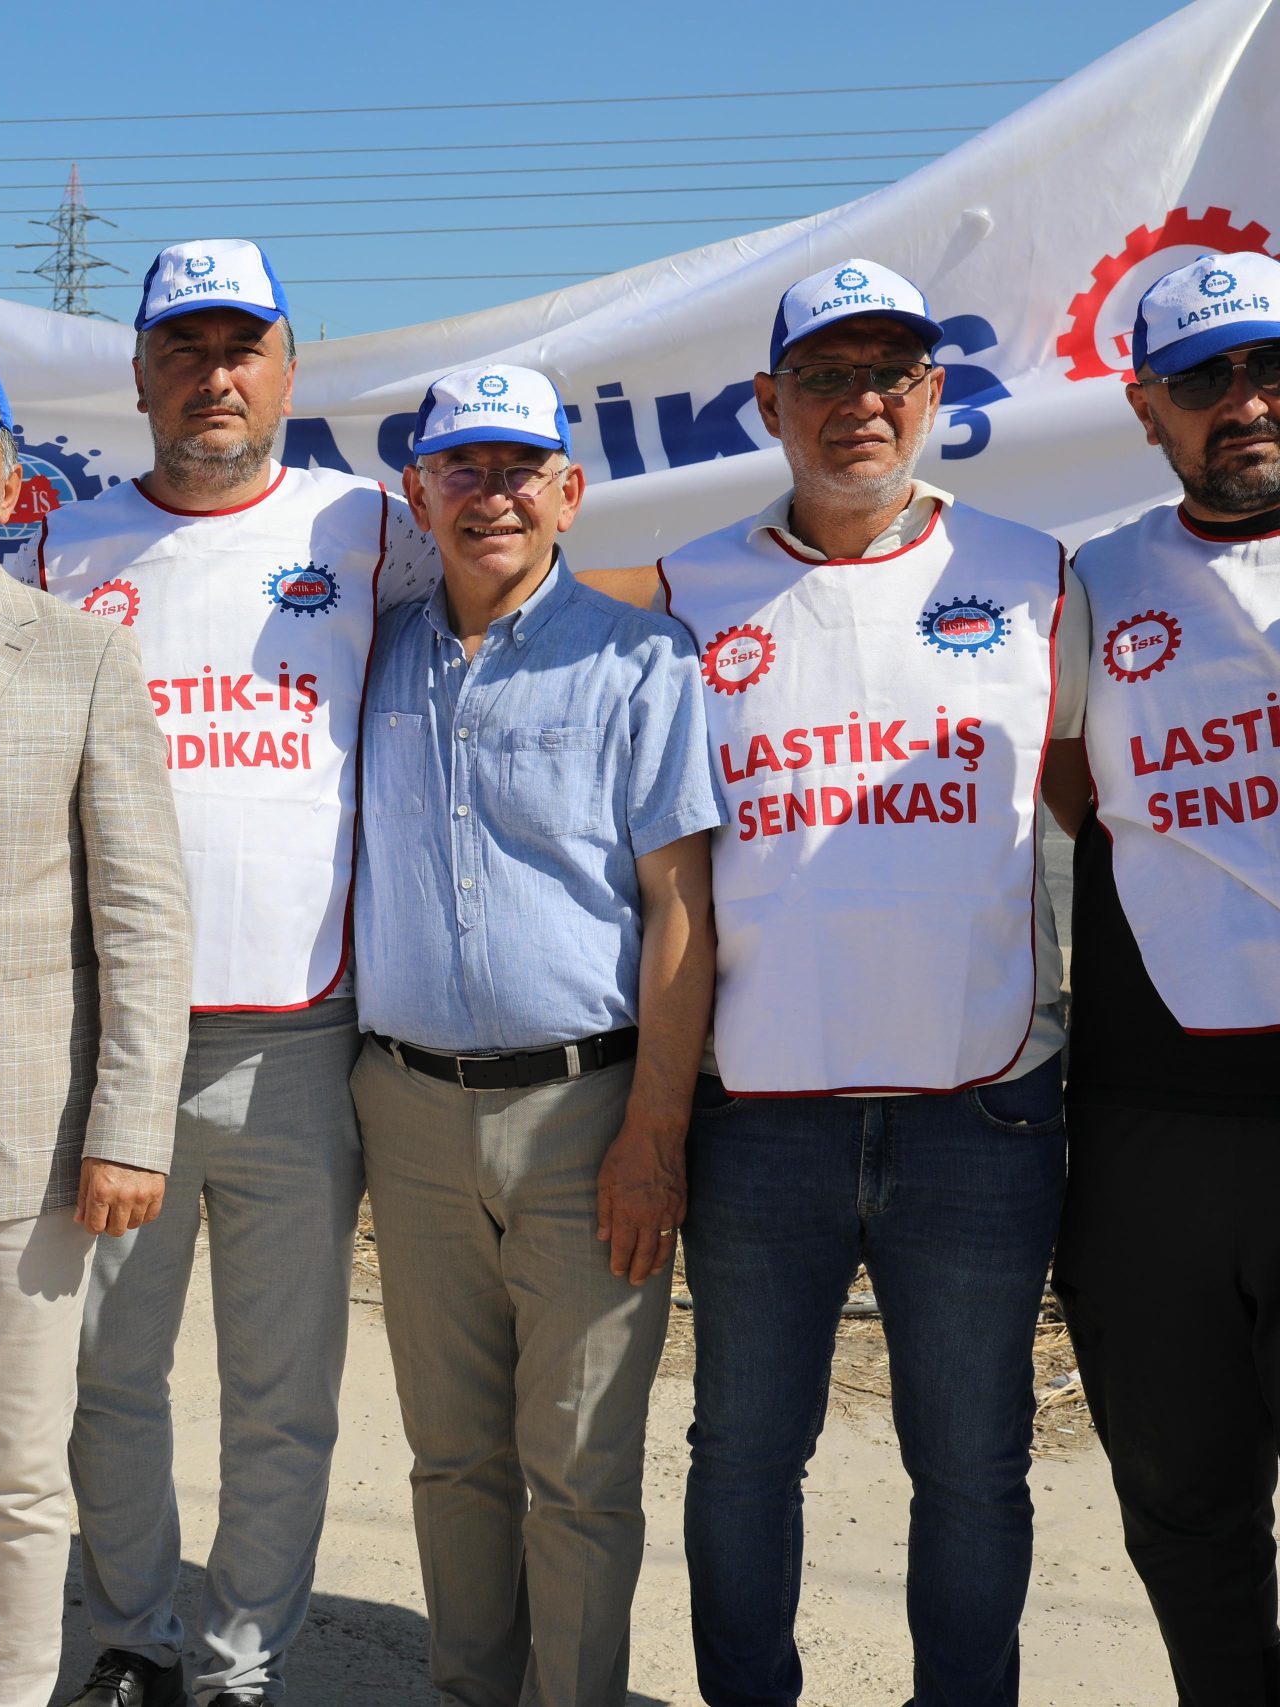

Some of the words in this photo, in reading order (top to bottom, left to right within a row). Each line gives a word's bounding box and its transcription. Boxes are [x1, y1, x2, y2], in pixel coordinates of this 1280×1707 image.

[168, 278, 240, 302] LASTİK-İŞ
[1177, 294, 1270, 330] LASTİK-İŞ
[454, 399, 530, 419] LASTİK-İŞ
[718, 648, 762, 669] DİSK
[1117, 635, 1164, 656] DİSK
[147, 661, 318, 723] STİK-İŞ
[165, 721, 311, 770] DİKASI
[720, 705, 985, 784] LASTİK-İŞ
[1130, 692, 1280, 776] LASTİ
[738, 773, 977, 842] SENDİKASI
[1148, 775, 1279, 833] SEND
